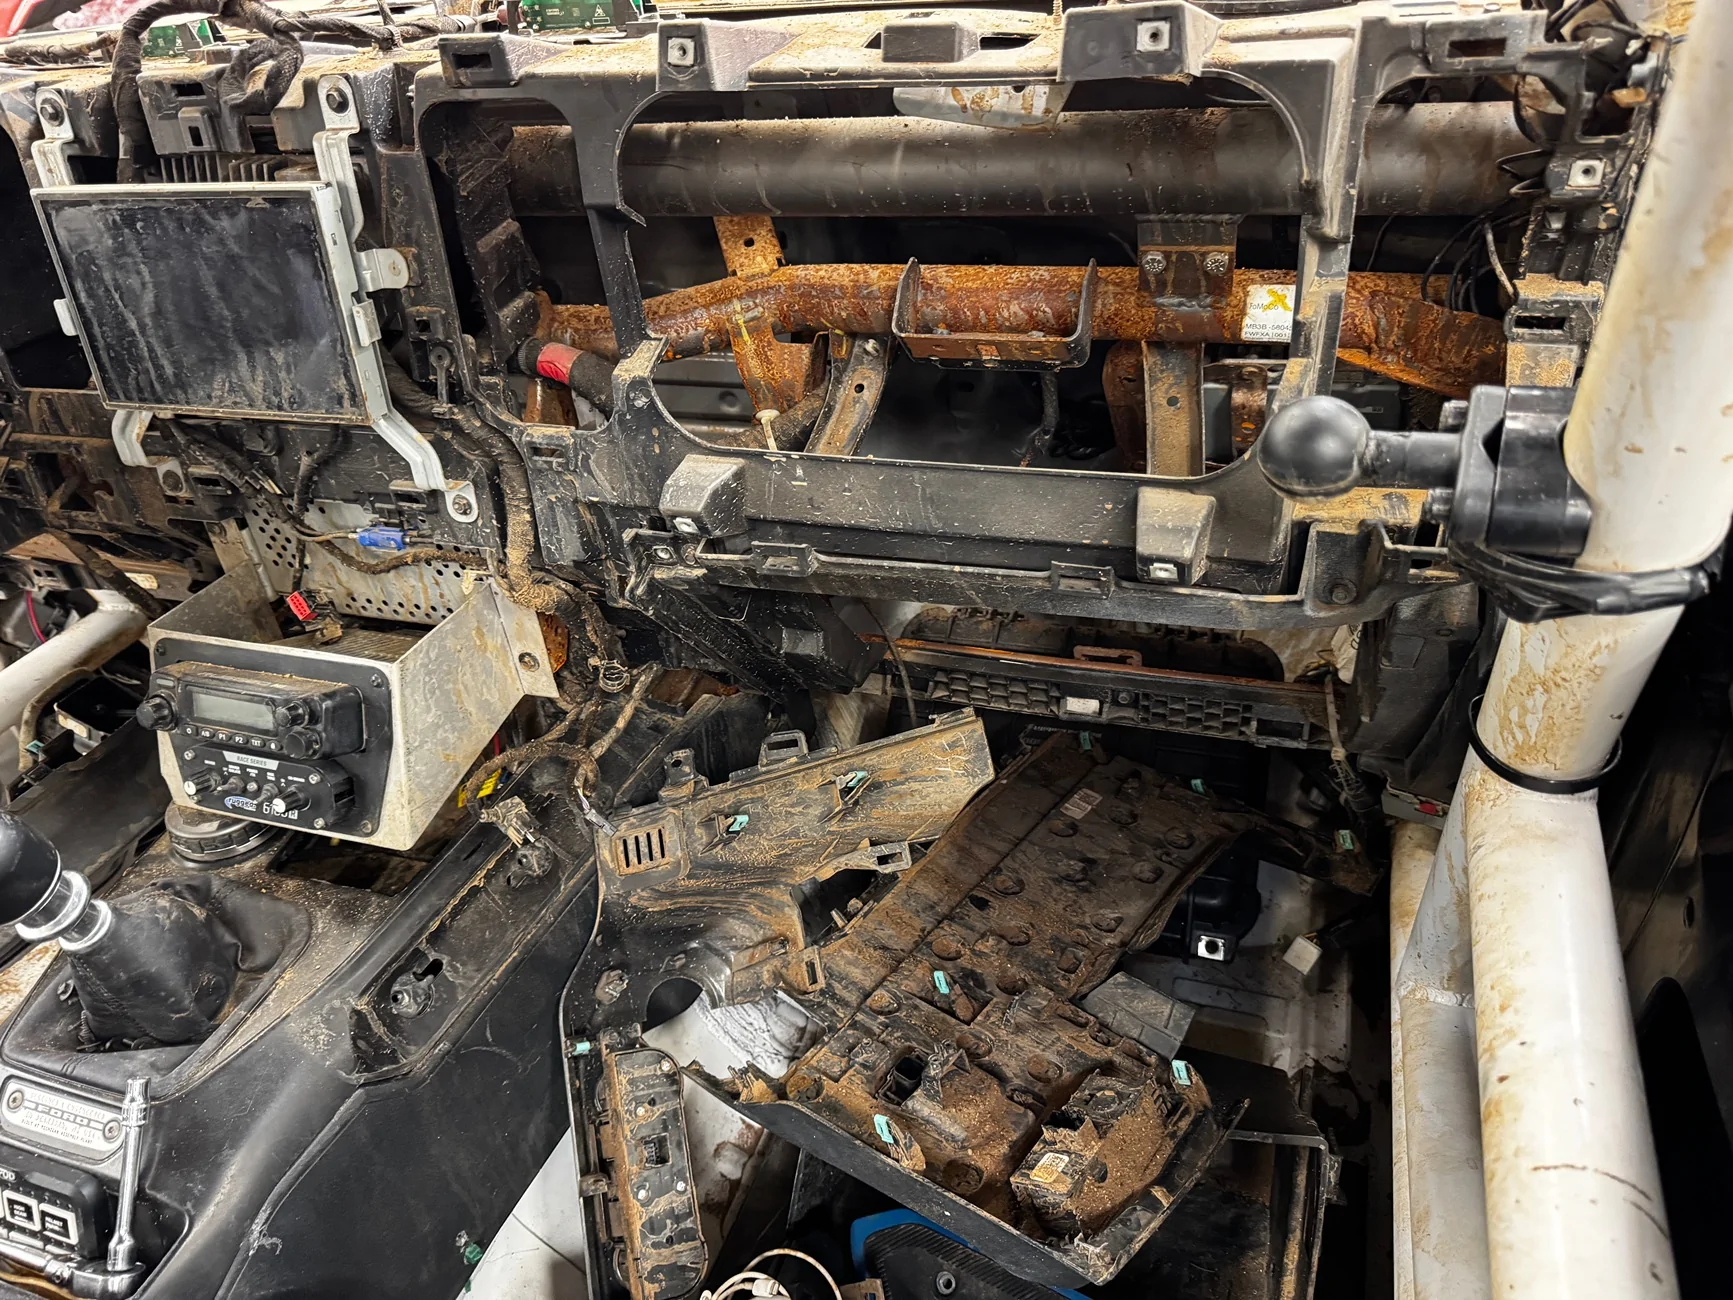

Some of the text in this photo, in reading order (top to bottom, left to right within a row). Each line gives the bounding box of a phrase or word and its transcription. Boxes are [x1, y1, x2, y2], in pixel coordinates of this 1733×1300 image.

[1249, 302, 1279, 310] FoMoCo
[251, 739, 261, 747] TXT
[237, 755, 267, 766] RACE SERIES
[36, 1103, 89, 1126] FORD
